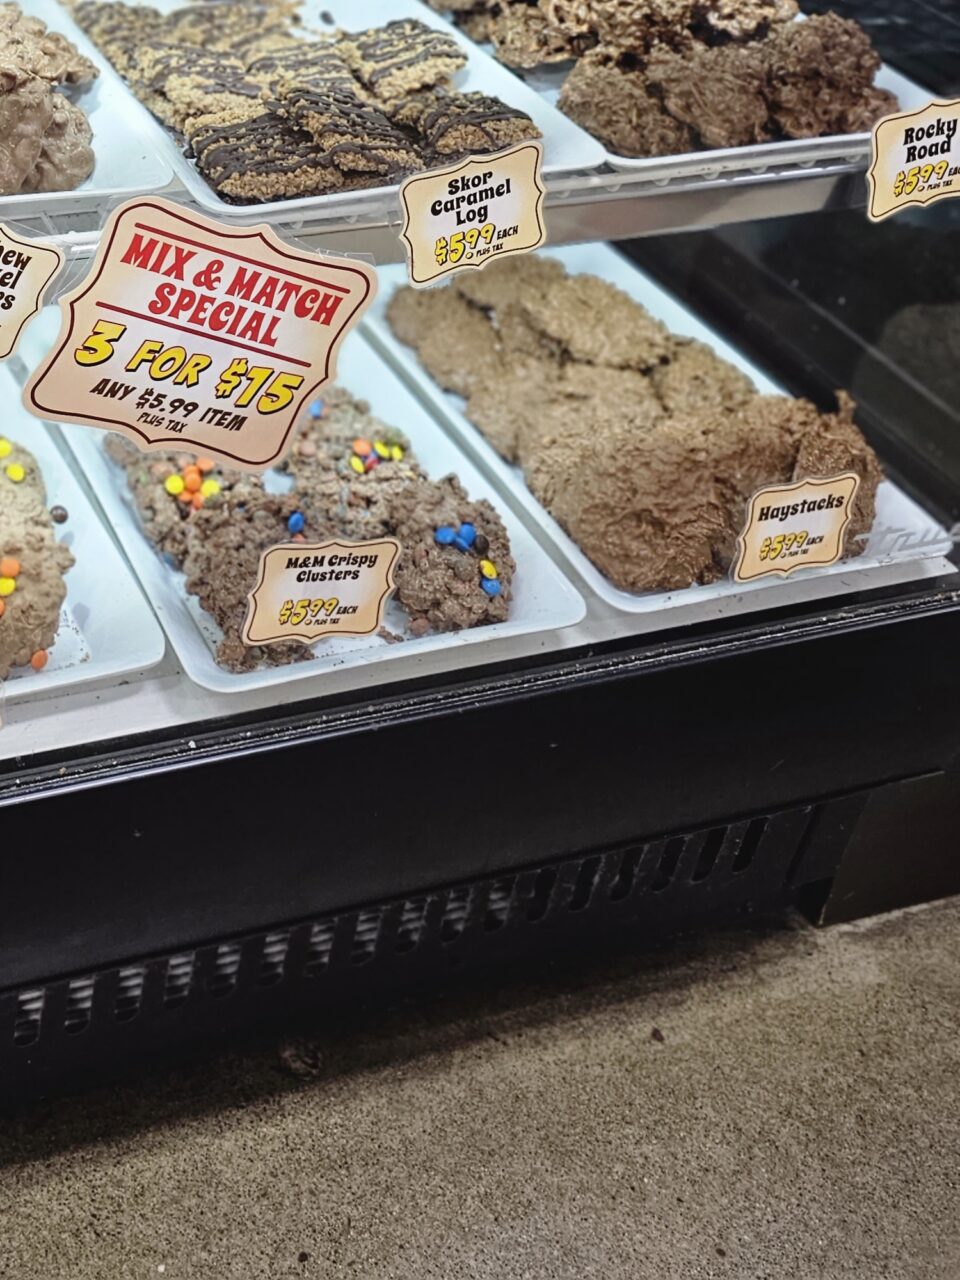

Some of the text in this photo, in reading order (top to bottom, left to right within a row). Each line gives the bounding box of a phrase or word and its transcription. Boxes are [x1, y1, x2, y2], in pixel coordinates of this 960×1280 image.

[903, 118, 959, 146] Rocky
[905, 135, 952, 164] Road
[430, 178, 512, 216] Caramel
[448, 171, 493, 195] Skor
[456, 204, 488, 226] Log
[434, 223, 519, 266] $5.99 EACH
[476, 242, 504, 258] PLUS TAX
[120, 233, 344, 327] MIX & MATCH
[147, 282, 283, 348] SPECIAL
[73, 319, 305, 415] 3 FOR $15
[89, 377, 249, 432] ANY $5.99 ITEM
[136, 411, 189, 435] PLUS TAX
[757, 494, 846, 523] Haystacks
[285, 552, 379, 569] M&M Crispy
[296, 569, 361, 583] Clusters
